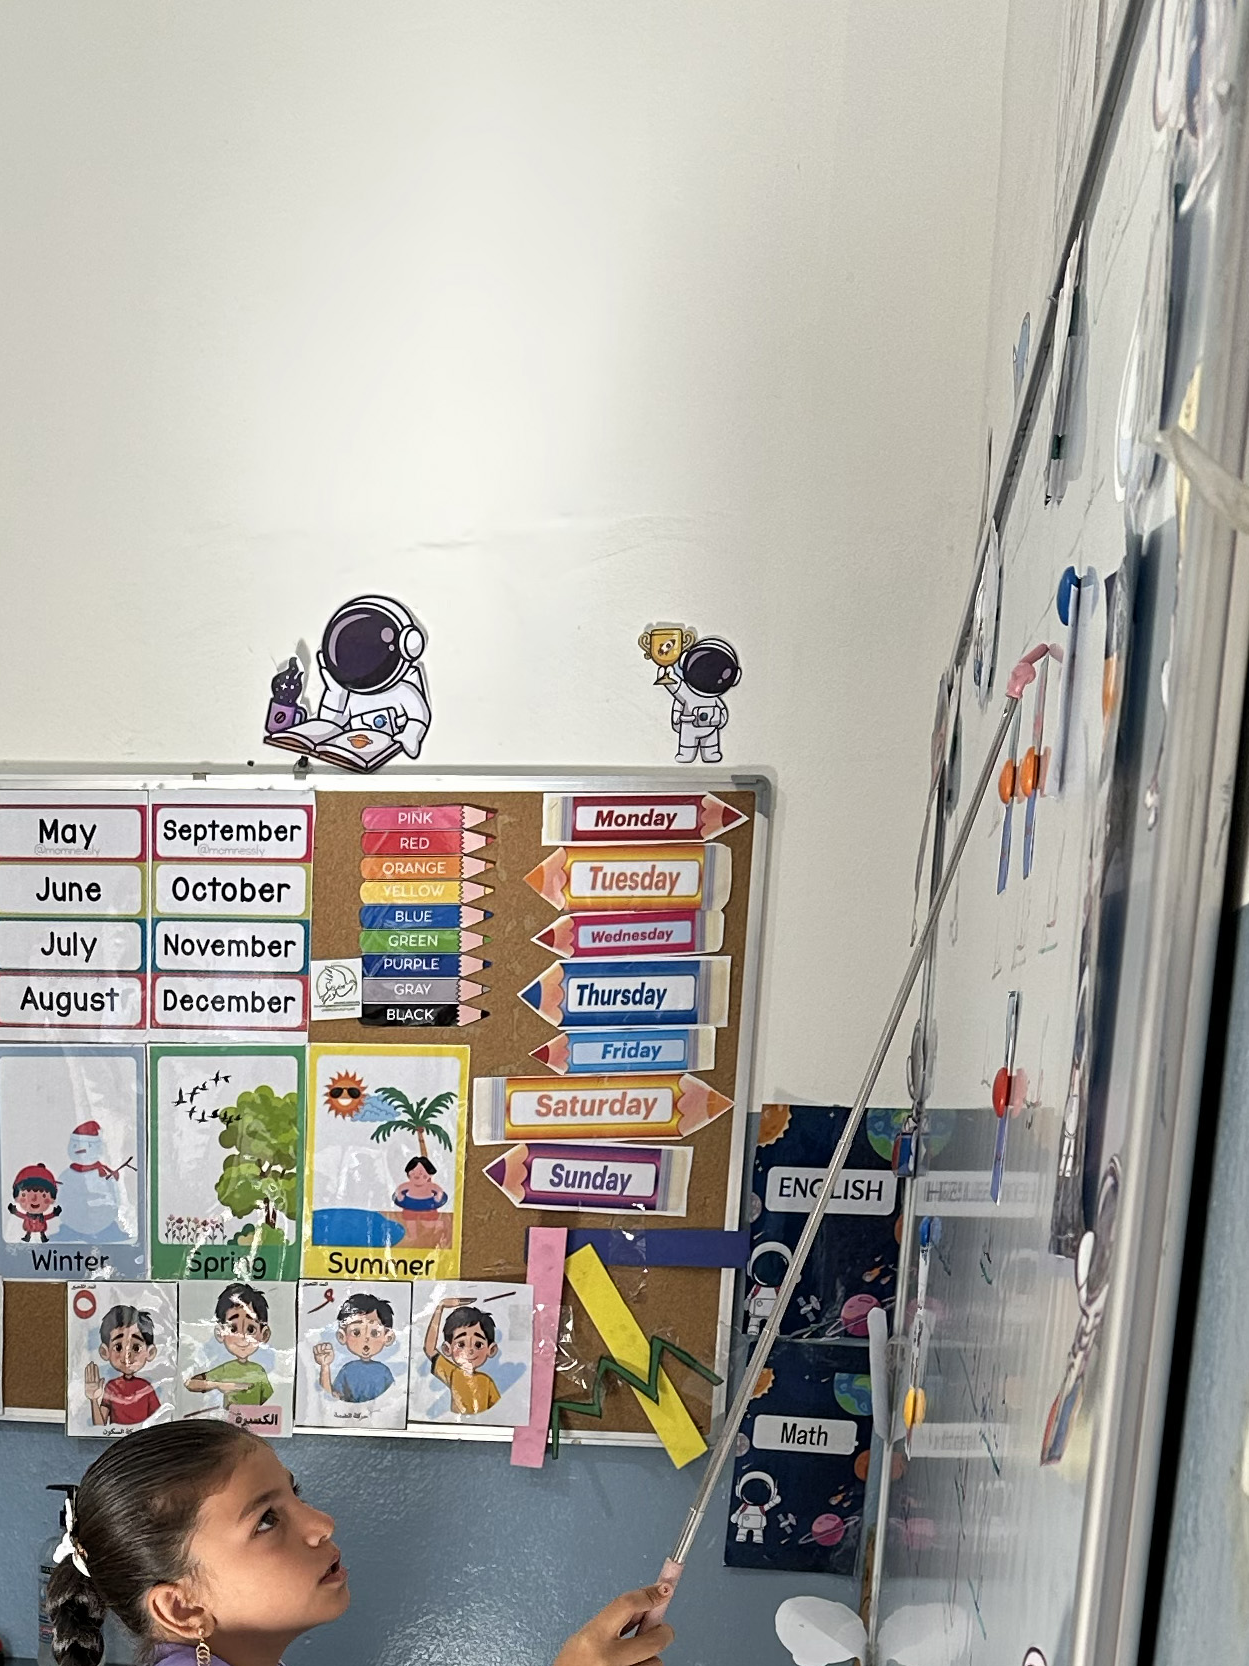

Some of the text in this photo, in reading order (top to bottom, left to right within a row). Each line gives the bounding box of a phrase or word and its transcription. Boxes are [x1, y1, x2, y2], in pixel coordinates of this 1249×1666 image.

[398, 812, 432, 824] PINK
[594, 808, 677, 830] Monday
[38, 818, 96, 850] May
[162, 820, 302, 846] September
[400, 838, 430, 849] RED
[382, 862, 446, 874] ORANGE
[36, 876, 102, 902] June
[172, 876, 290, 903] October
[383, 885, 445, 897] YELLOW
[590, 864, 680, 896] Tuesday
[395, 911, 433, 922] BLUE
[41, 932, 98, 962] July
[164, 933, 296, 958] November
[388, 935, 438, 946] GREEN
[591, 929, 674, 943] Wednesday
[384, 958, 440, 970] PURPLE
[394, 984, 432, 994] GRAY
[576, 982, 668, 1008] Thursday
[20, 986, 119, 1018] August
[162, 989, 296, 1014] December
[386, 1009, 434, 1020] BLACK
[602, 1042, 662, 1061] Friday
[535, 1092, 658, 1120] Saturday
[549, 1163, 632, 1195] Sunday
[32, 1250, 109, 1272] Winter
[328, 1252, 434, 1276] Summer
[235, 1412, 278, 1426] الكسرة
[780, 1422, 828, 1447] Math
